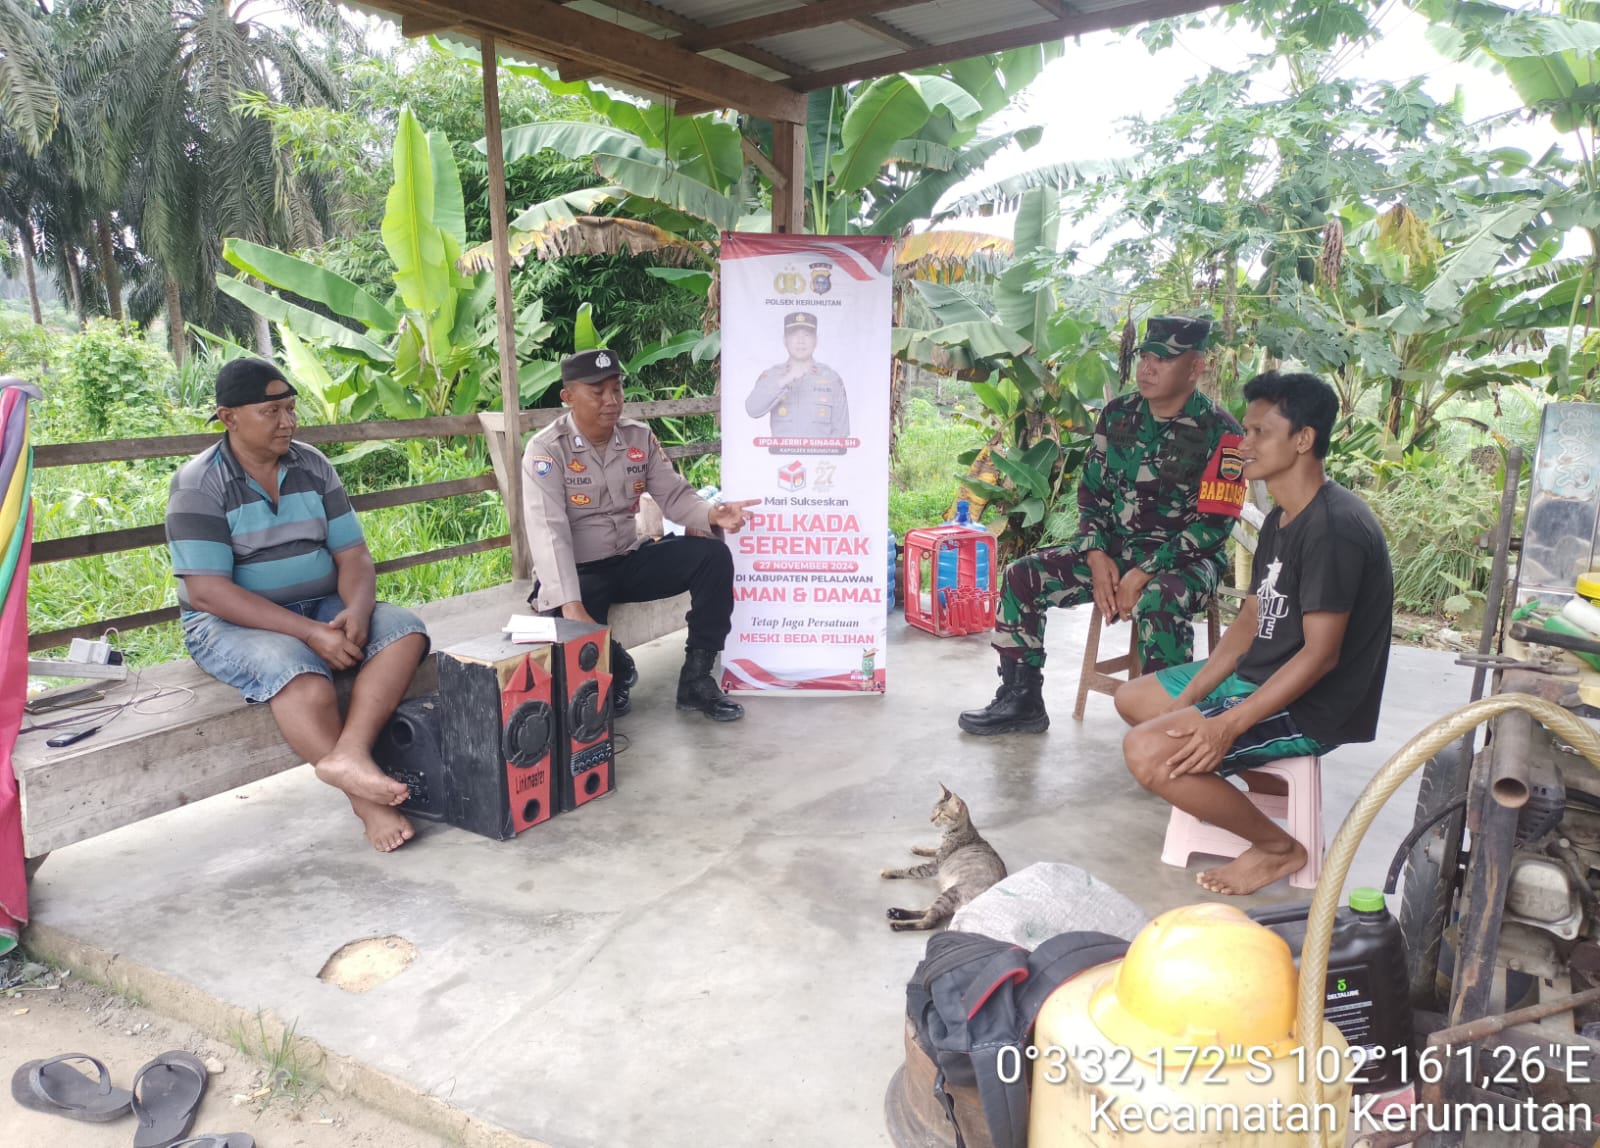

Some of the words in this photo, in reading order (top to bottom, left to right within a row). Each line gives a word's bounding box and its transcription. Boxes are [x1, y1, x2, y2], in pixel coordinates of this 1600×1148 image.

[764, 497, 787, 506] Mari
[790, 497, 849, 507] Sukseskan
[750, 514, 860, 533] PILKADA
[739, 536, 870, 556] SERENTAK
[773, 562, 828, 570] NOVEMBER
[831, 562, 855, 570] 2024
[735, 574, 746, 582] DI
[811, 575, 874, 583] PELALAWAN
[793, 587, 808, 602] &
[814, 587, 881, 603] DAMAI
[751, 616, 779, 628] Tetap
[781, 617, 804, 629] Jaga
[807, 618, 859, 628] Persatuan
[740, 633, 780, 643] MESKI
[784, 633, 817, 643] BEDA
[821, 633, 875, 644] PILIHAN
[514, 769, 545, 795] Linkmaster
[1327, 990, 1360, 1000] DELTALUBE
